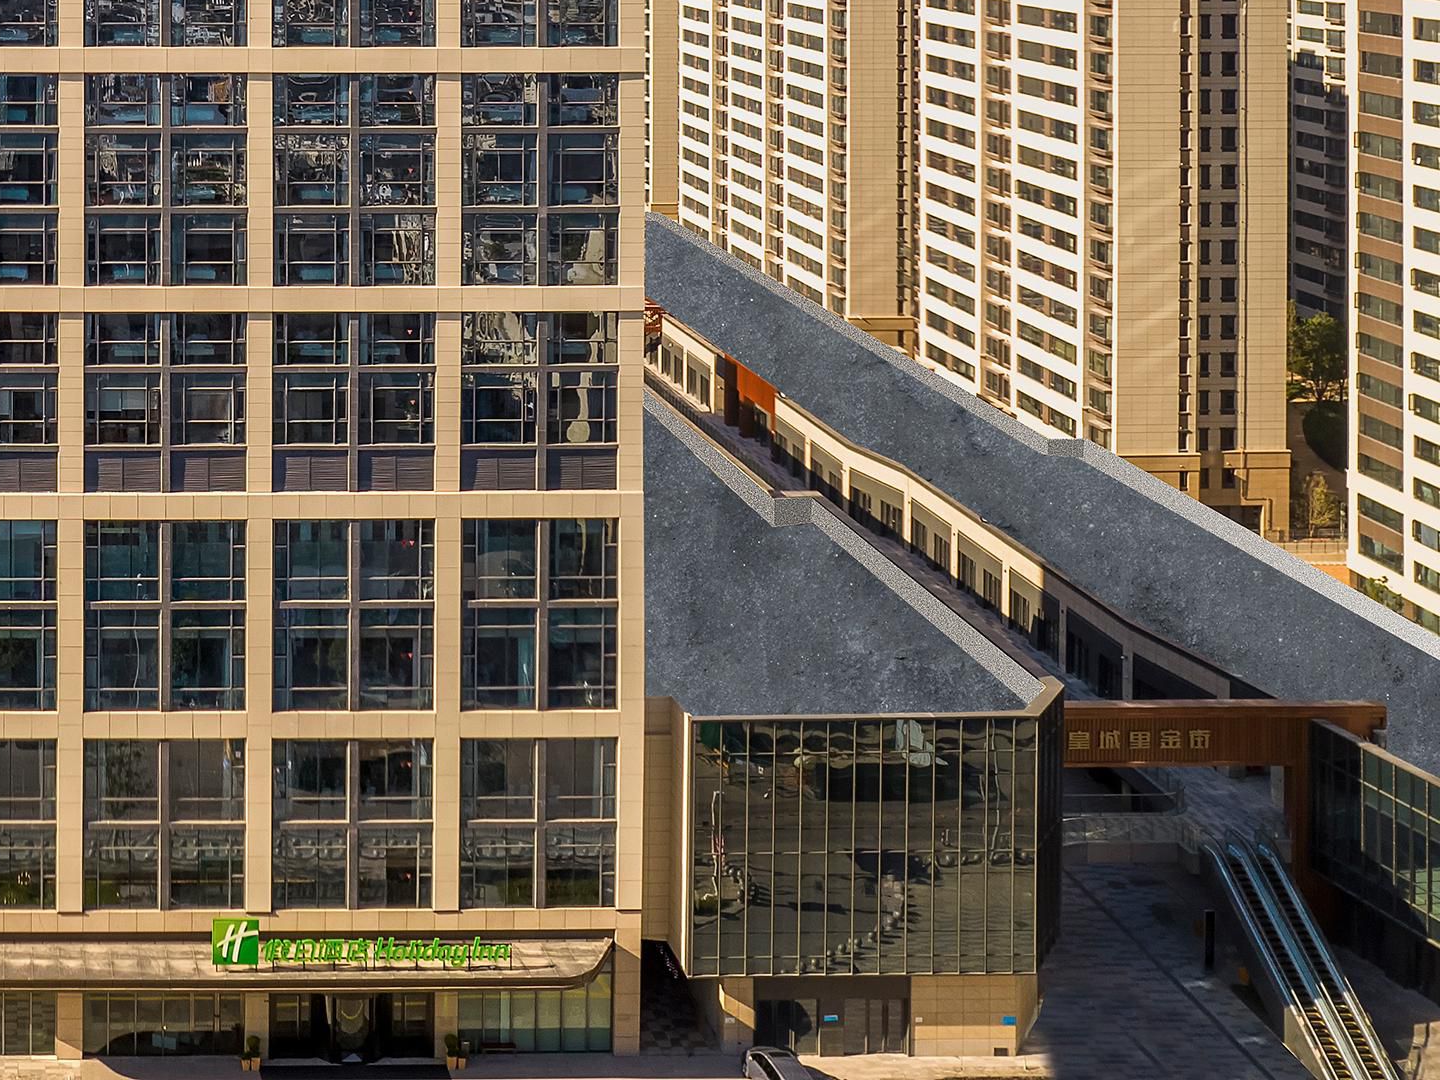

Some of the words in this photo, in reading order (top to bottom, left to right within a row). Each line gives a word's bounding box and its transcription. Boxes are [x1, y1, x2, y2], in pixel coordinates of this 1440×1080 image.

[262, 938, 371, 962] 假日酒店
[373, 936, 467, 967] Holiday
[471, 935, 511, 962] Inn
